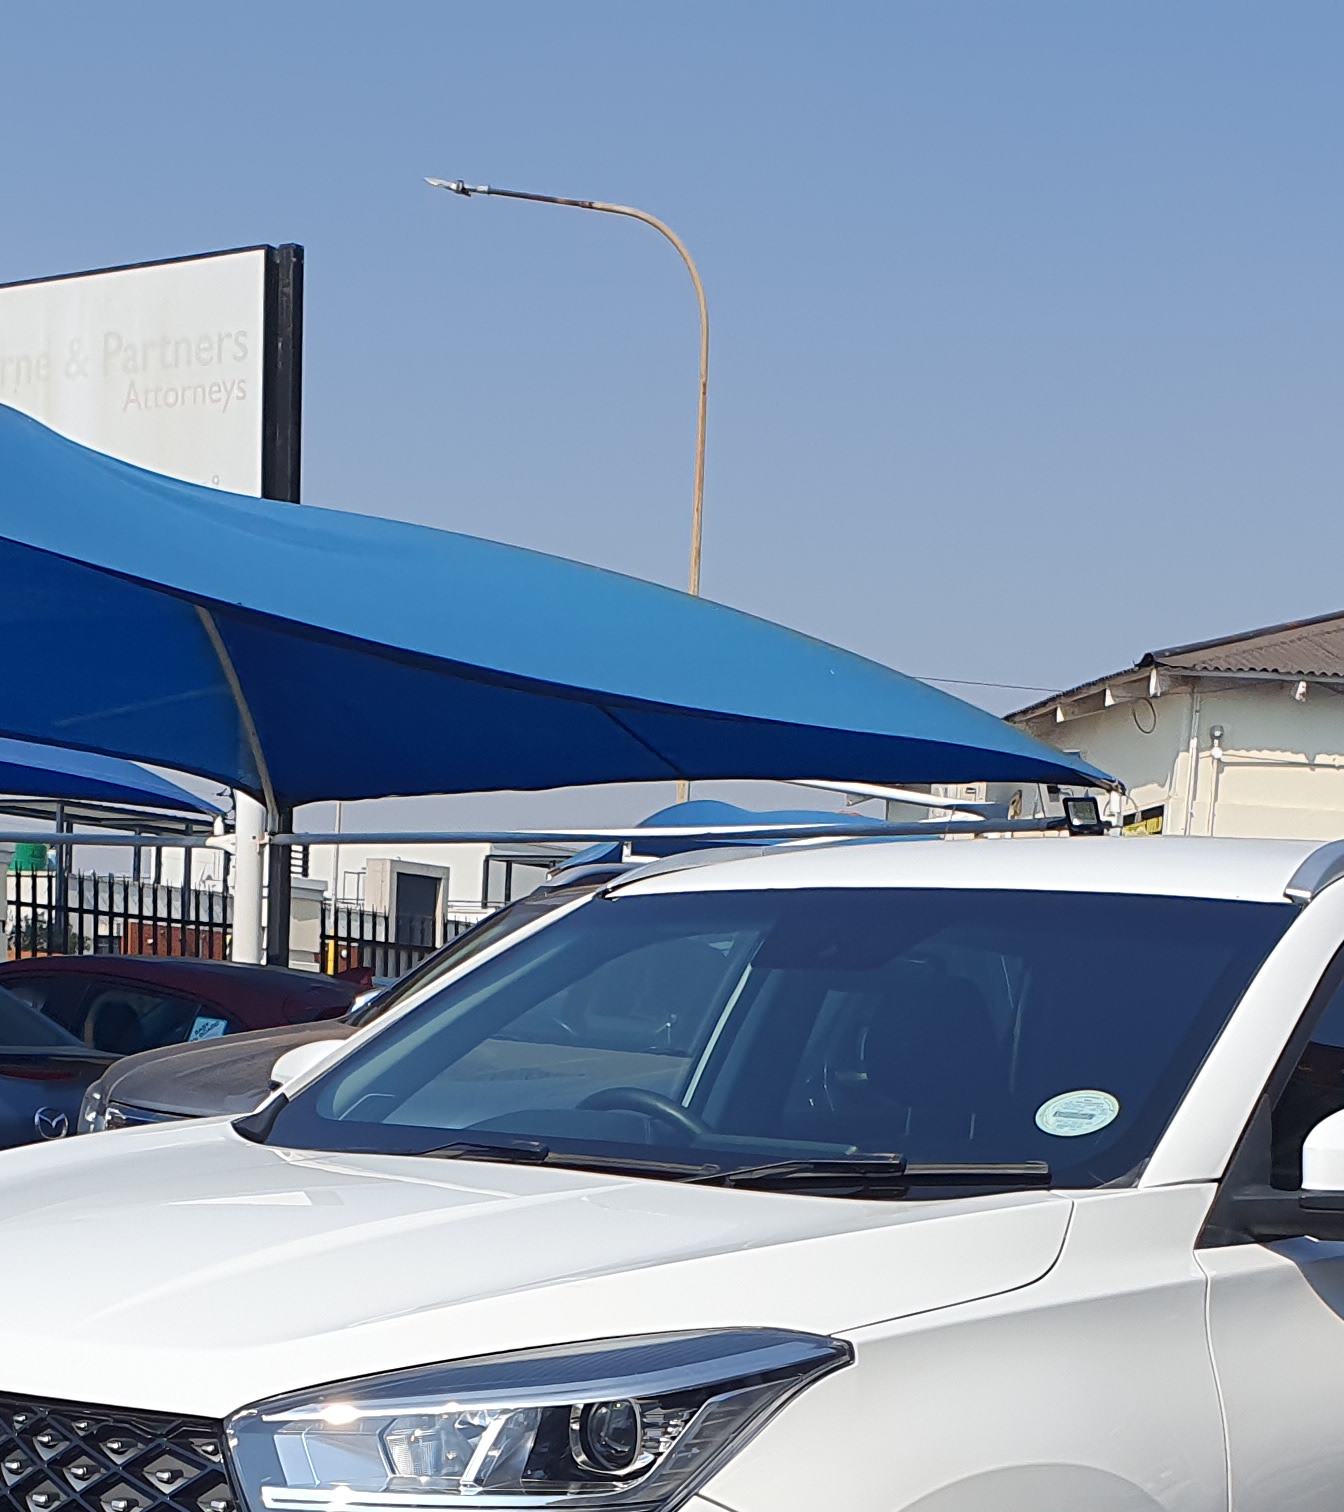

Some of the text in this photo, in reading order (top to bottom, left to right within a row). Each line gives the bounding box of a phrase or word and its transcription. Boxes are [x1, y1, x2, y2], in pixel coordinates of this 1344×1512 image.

[65, 336, 88, 379] &
[103, 329, 249, 377] Partners
[122, 378, 247, 413] Attorneys
